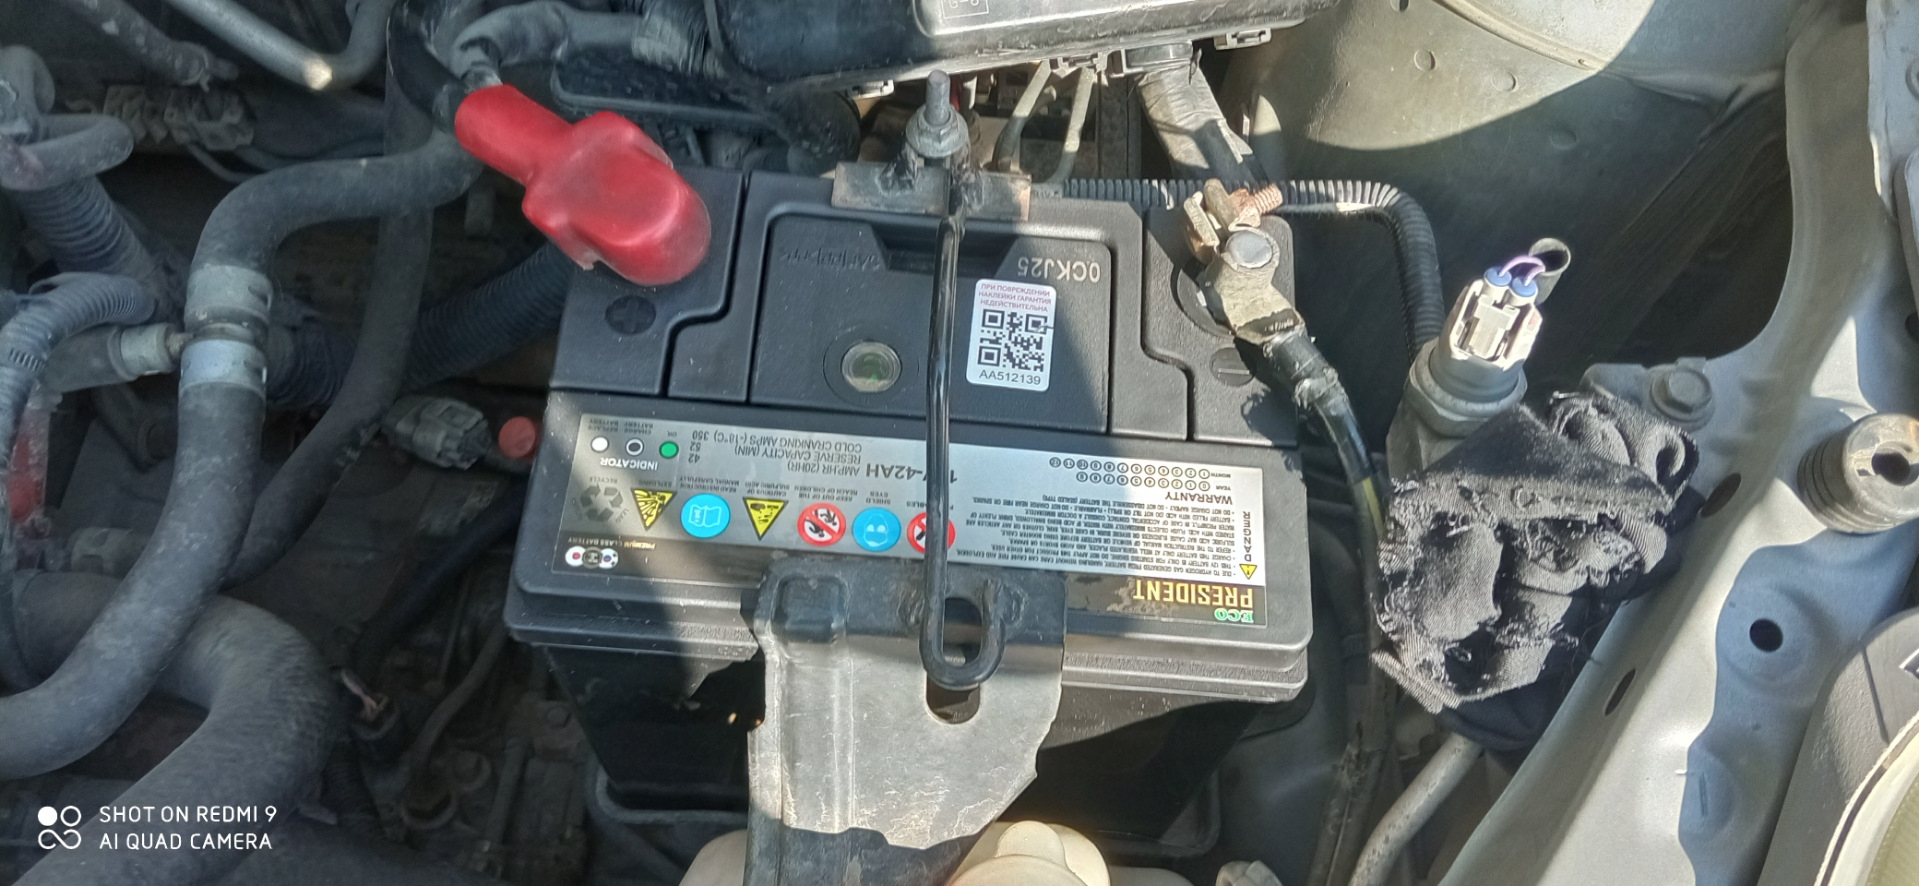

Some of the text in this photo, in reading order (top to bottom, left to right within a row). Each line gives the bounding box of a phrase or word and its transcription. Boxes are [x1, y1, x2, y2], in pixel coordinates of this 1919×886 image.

[981, 283, 1050, 297] ПРИ ПОВРЕЖДЕНИИ
[979, 291, 1052, 305] НАКЛЕЙКИ ГАРАНТИЯ
[980, 299, 1048, 312] НЕДЕЙСТВИТЕЛЬНА
[979, 369, 1042, 385] AA512139
[691, 430, 710, 441] 350
[749, 434, 778, 447] AMPS
[779, 437, 832, 451] CRANKING
[834, 441, 862, 454] COLD
[688, 453, 700, 464] 42
[689, 441, 861, 465] RESERVE CAPACITY (MIN) 52
[599, 456, 659, 471] INDICATOR
[787, 459, 820, 474] (20HR)
[1165, 491, 1232, 505] WARRANTY
[1133, 579, 1253, 608] PRESIDENT
[1214, 607, 1253, 623] ECO
